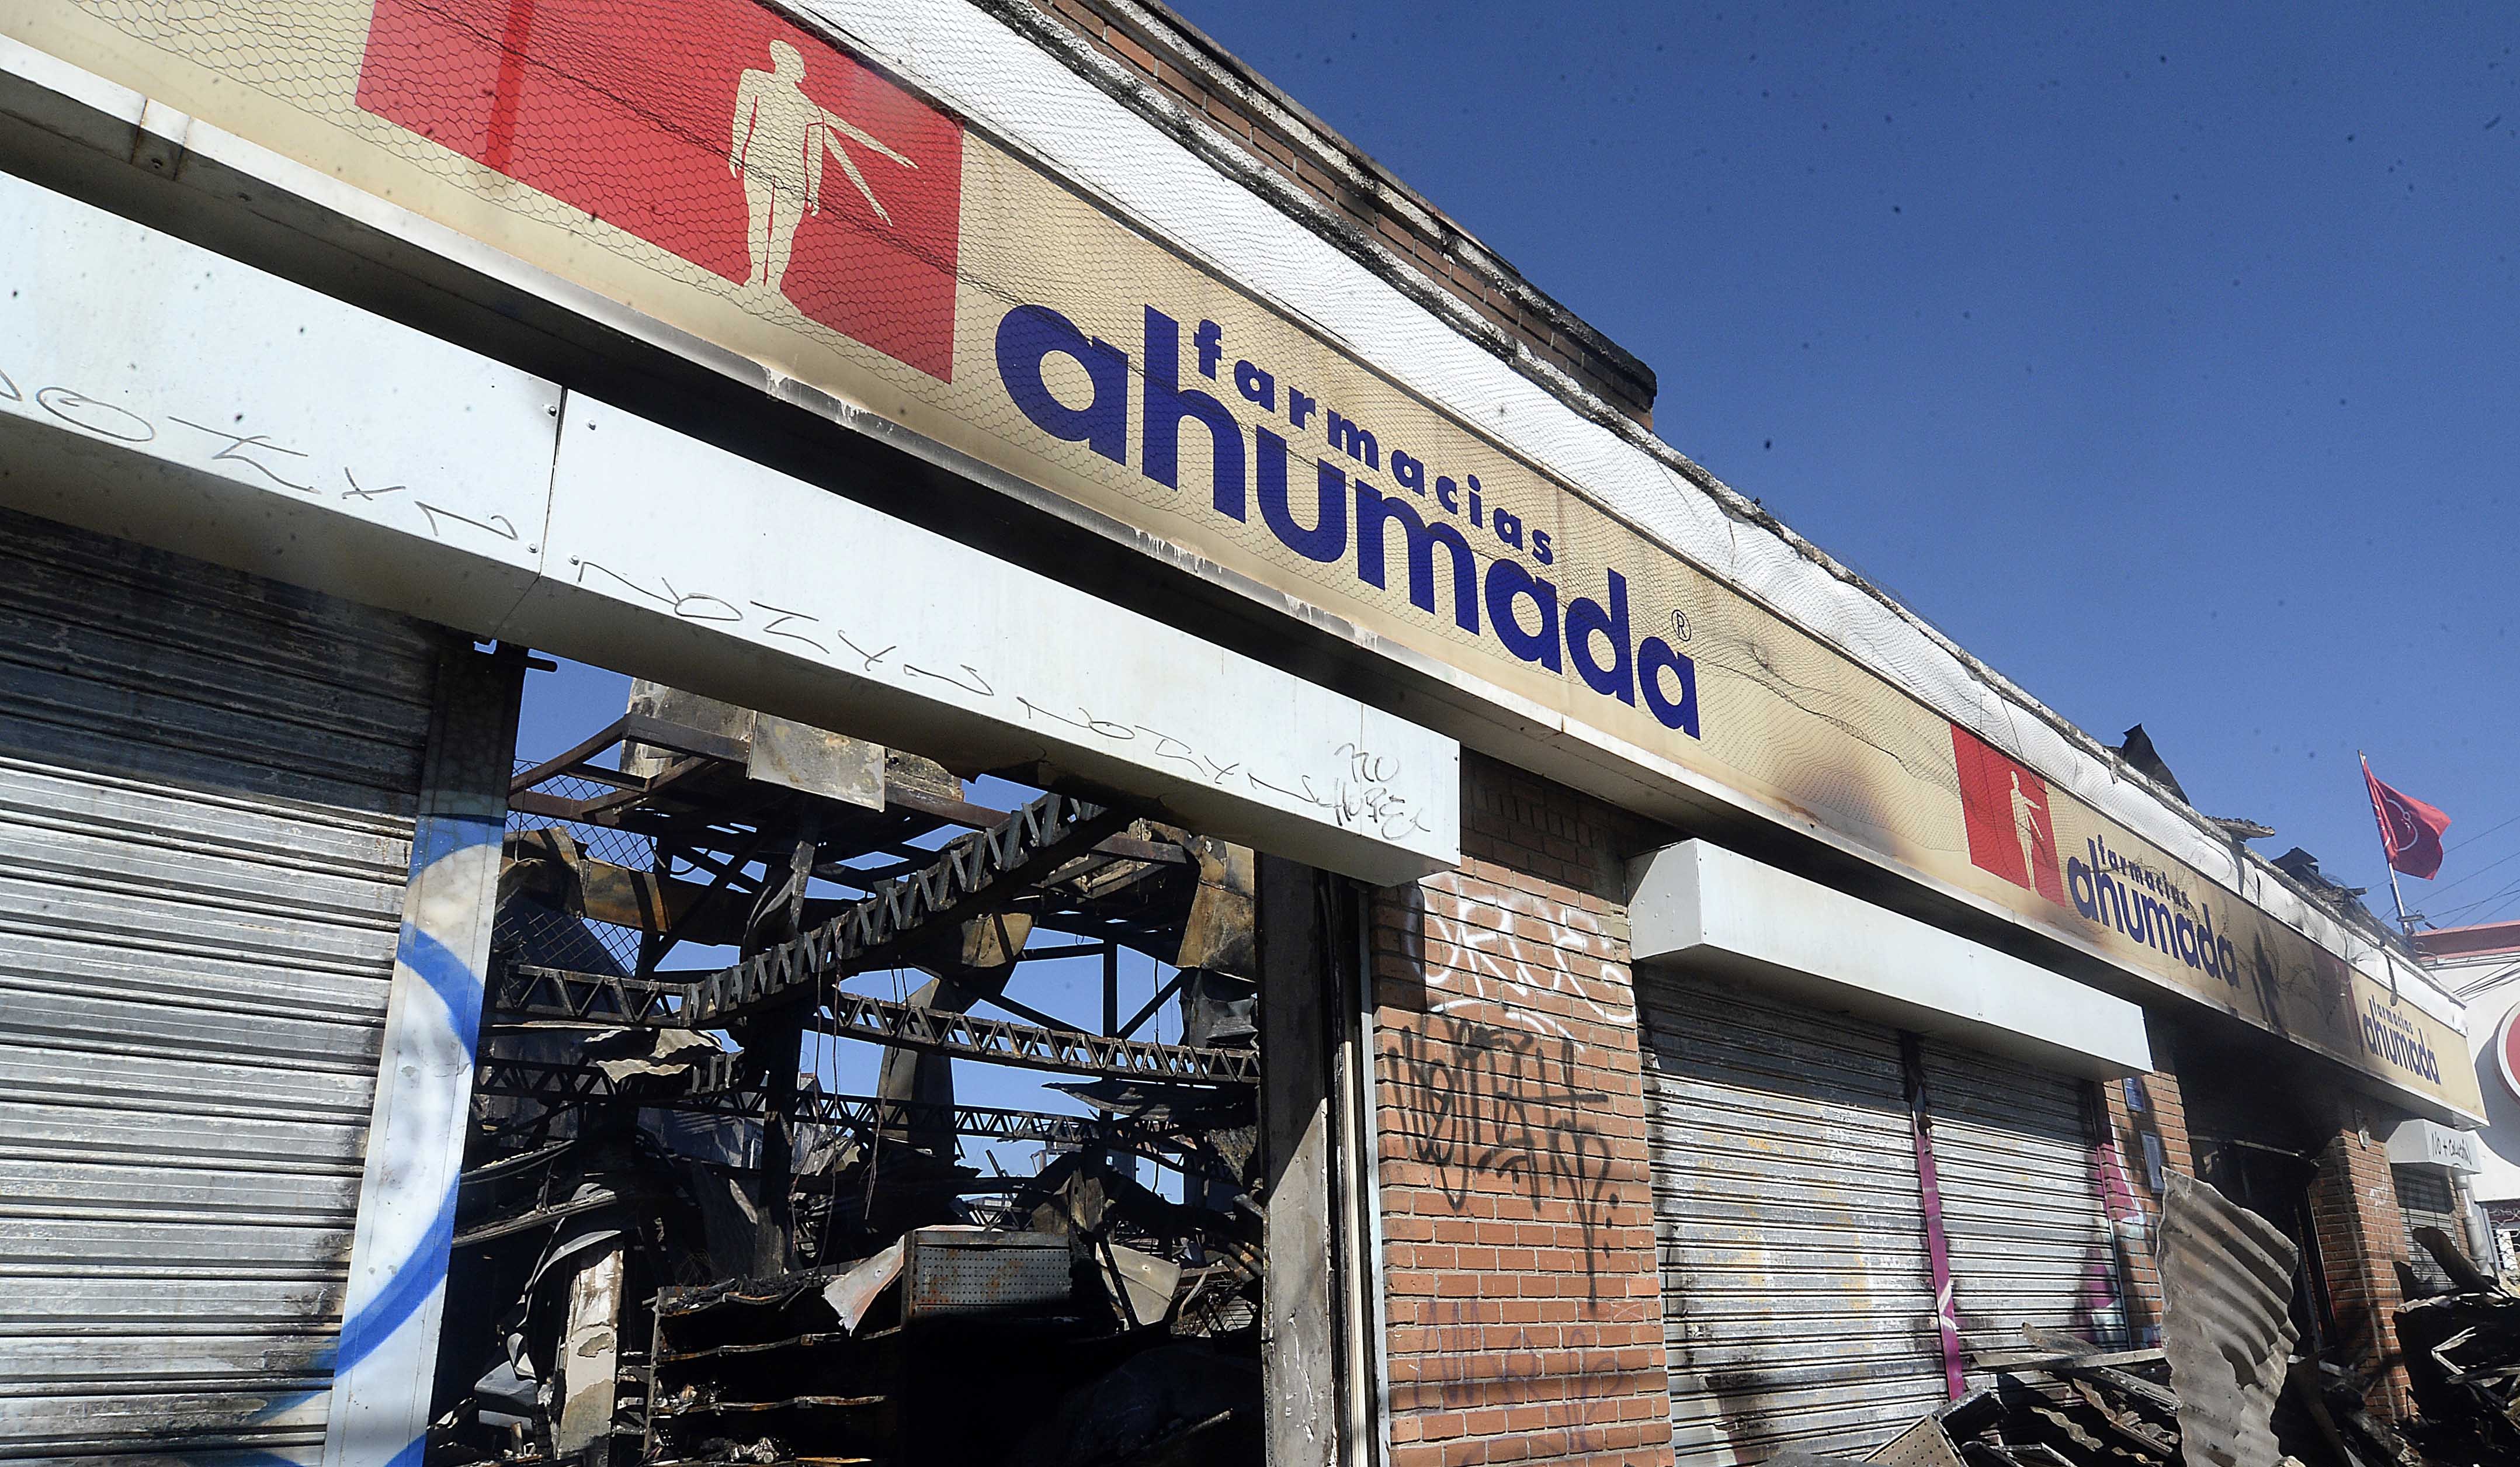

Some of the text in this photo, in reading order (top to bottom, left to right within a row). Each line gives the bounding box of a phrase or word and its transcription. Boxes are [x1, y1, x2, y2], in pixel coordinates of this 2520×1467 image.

[1194, 319, 1553, 566] farmacias
[995, 303, 1700, 740] ahumada
[2067, 837, 2241, 989] ahumada
[2098, 834, 2189, 910] farmacias
[2363, 998, 2441, 1085] ahumada
[2372, 994, 2414, 1035] farmacias
